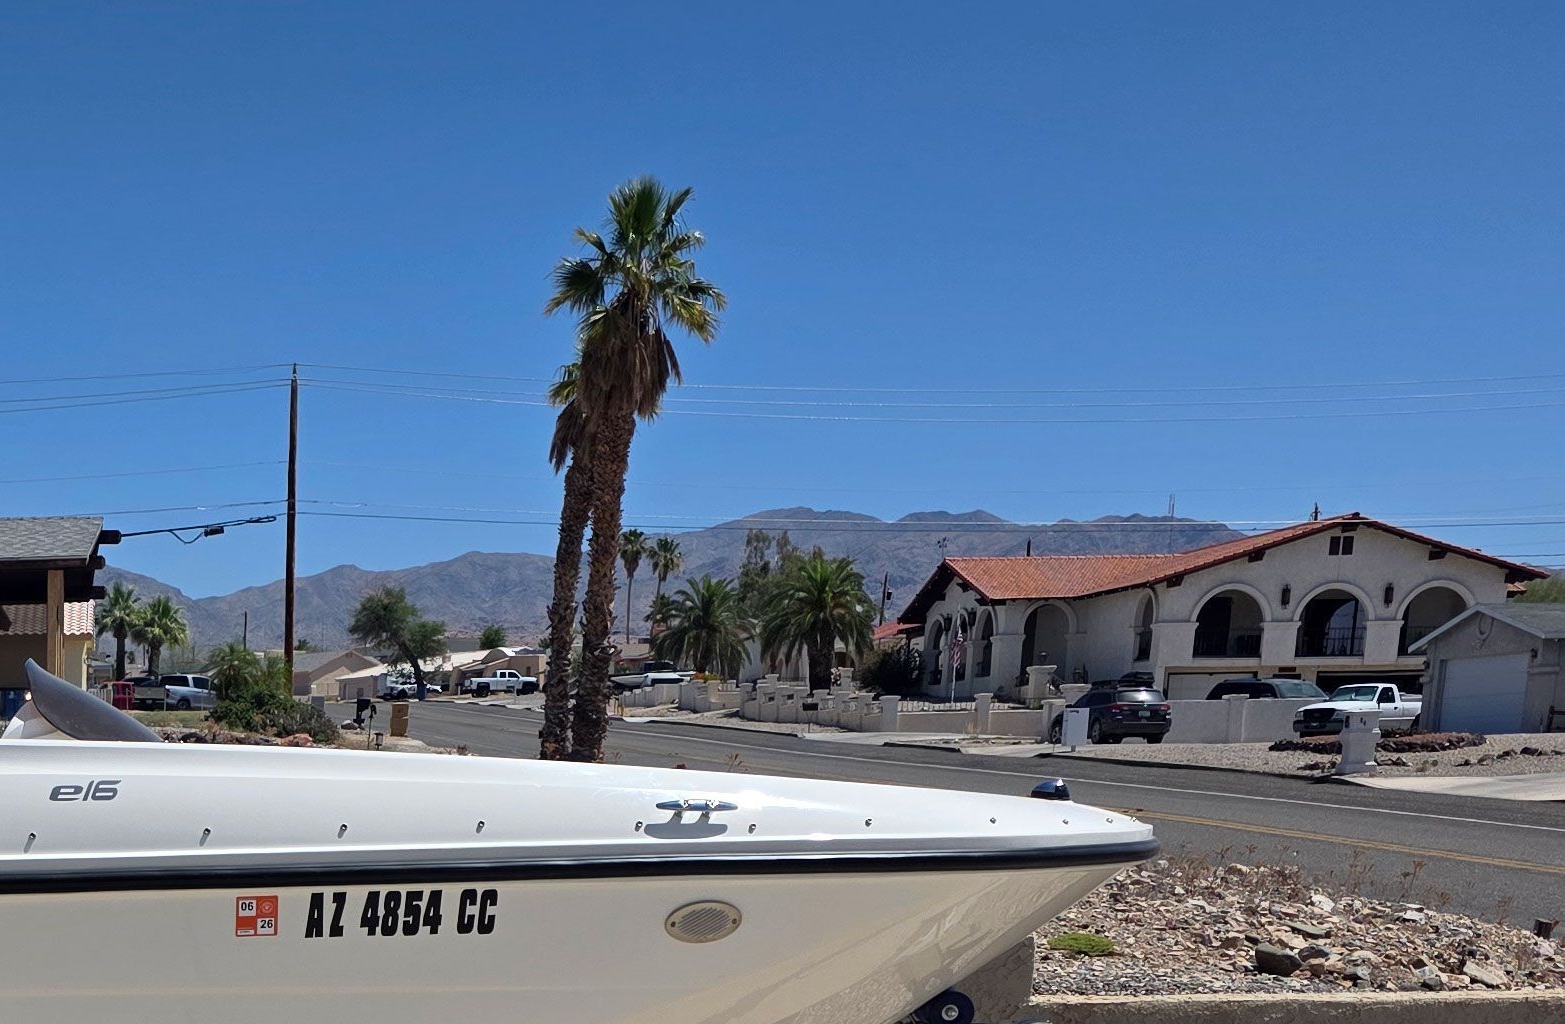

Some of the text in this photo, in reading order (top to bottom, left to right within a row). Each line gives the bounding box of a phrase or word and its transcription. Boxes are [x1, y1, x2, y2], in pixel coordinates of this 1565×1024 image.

[240, 901, 254, 911] 06
[304, 888, 499, 939] AZ 4854 CC
[260, 919, 274, 929] 26
